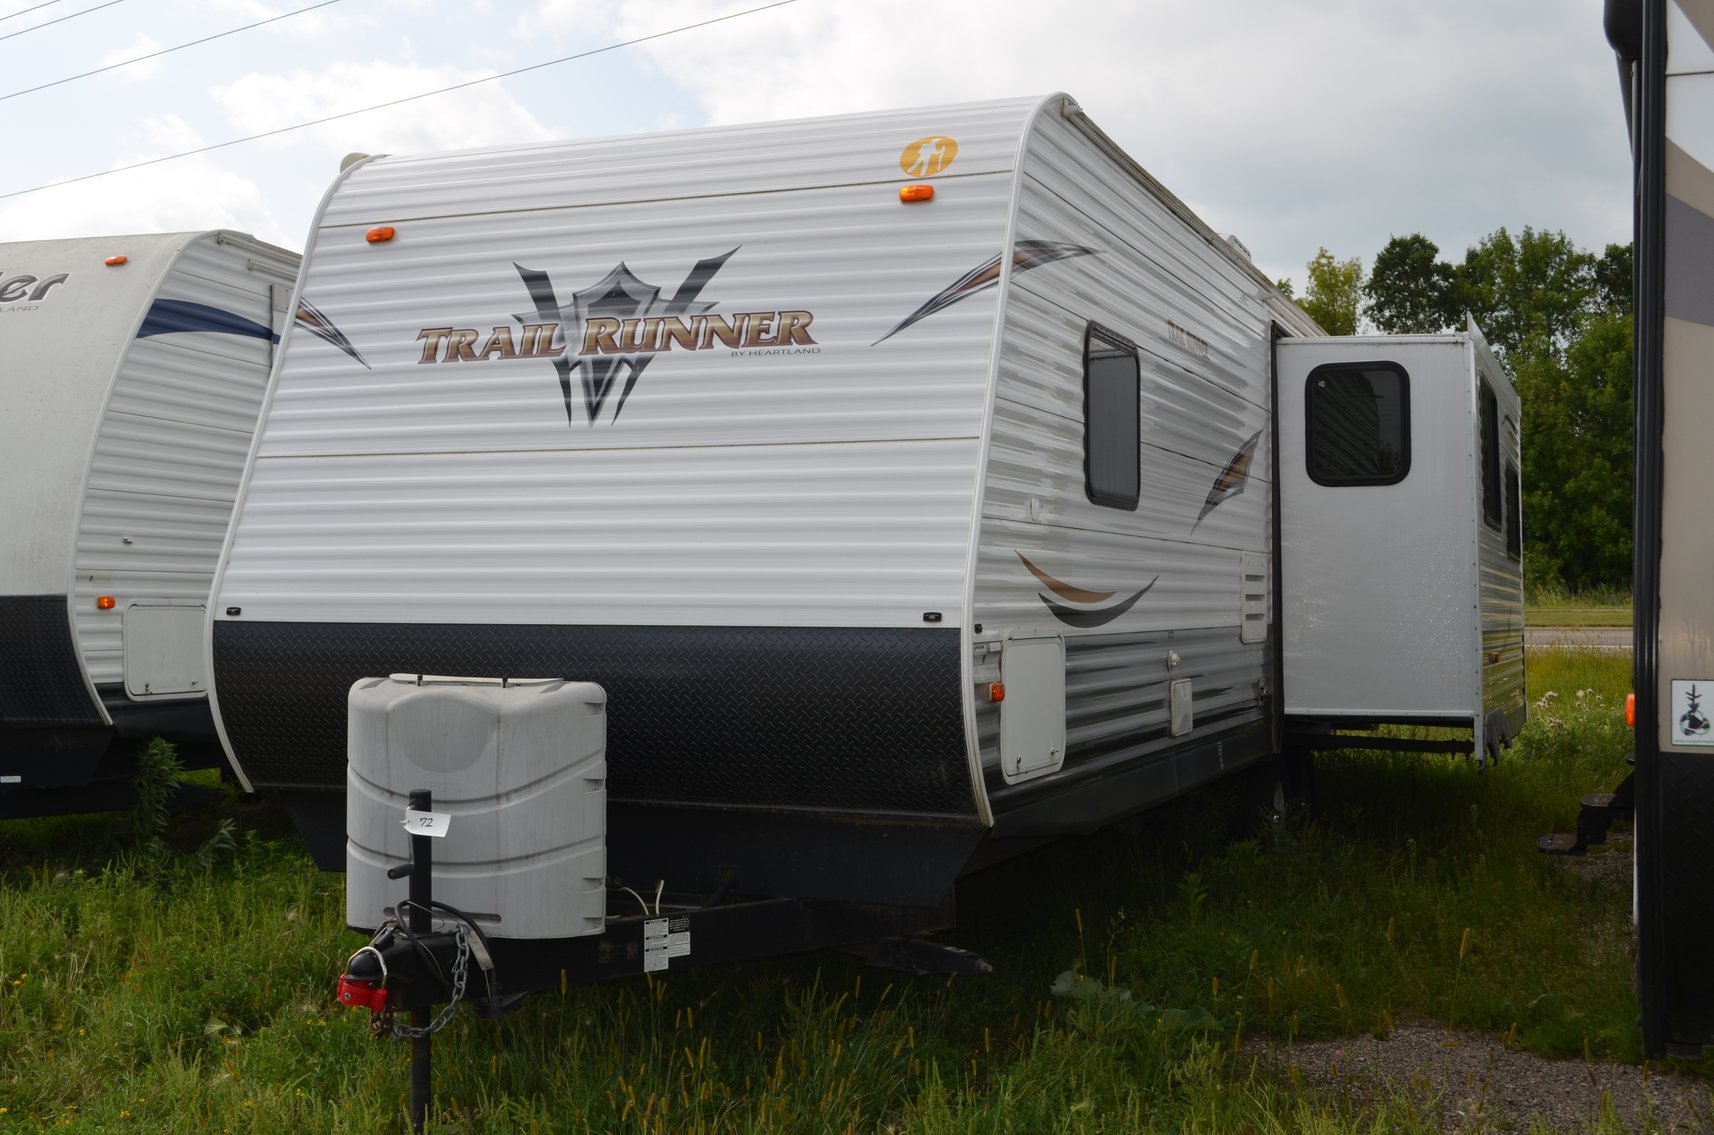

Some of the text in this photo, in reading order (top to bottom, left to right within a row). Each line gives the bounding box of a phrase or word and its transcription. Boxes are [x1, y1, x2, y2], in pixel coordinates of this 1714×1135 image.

[0, 271, 71, 303] er
[416, 310, 818, 364] TRAIL RUNNER
[731, 347, 821, 358] BY HEARTLAND
[420, 817, 433, 828] 72
